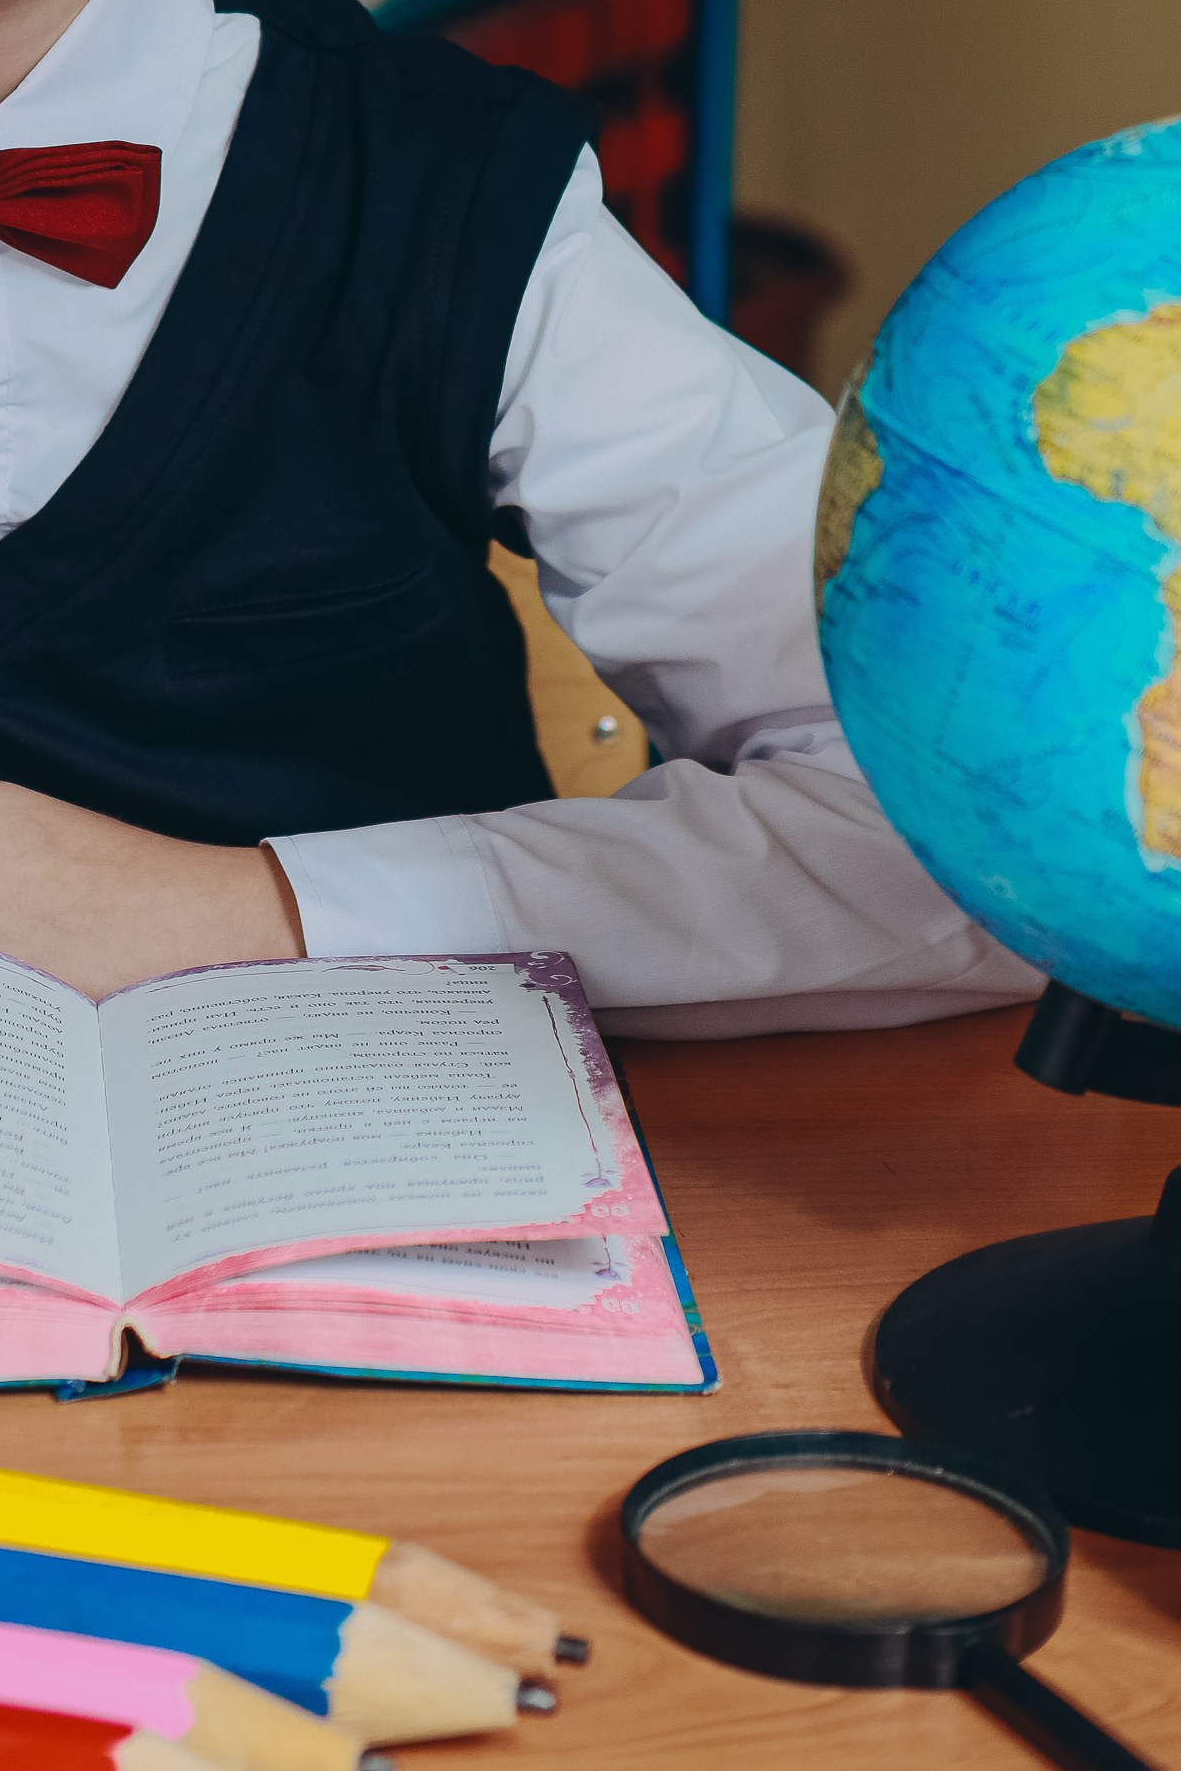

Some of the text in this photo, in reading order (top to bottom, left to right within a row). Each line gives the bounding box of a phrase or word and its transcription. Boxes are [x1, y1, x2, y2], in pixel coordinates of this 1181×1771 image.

[468, 963, 497, 971] 206
[395, 989, 423, 997] что
[376, 997, 404, 1007] что
[30, 1005, 62, 1024] бурь
[205, 1010, 237, 1020] Или
[201, 1017, 269, 1031] ответила
[472, 1018, 500, 1026] ред
[431, 1028, 503, 1036] спросила
[228, 1038, 277, 1049] прямо
[297, 1042, 342, 1051] видят
[30, 1040, 64, 1058] бури
[179, 1049, 206, 1059] них
[256, 1047, 288, 1058] нас?
[150, 1058, 219, 1080] шепотом
[314, 1062, 404, 1072] озадаченно
[413, 1061, 469, 1069] Стулья
[268, 1075, 375, 1088] остановилась
[383, 1073, 439, 1081] мебели
[38, 1079, 66, 1094] ном
[316, 1087, 359, 1096] этого
[215, 1086, 260, 1098] перед
[469, 1092, 521, 1100] дурачу
[288, 1103, 315, 1111] что
[323, 1098, 380, 1107] потому
[156, 1109, 207, 1129] ладно?
[218, 1107, 279, 1122] прячусь
[154, 1120, 210, 1140] внутри
